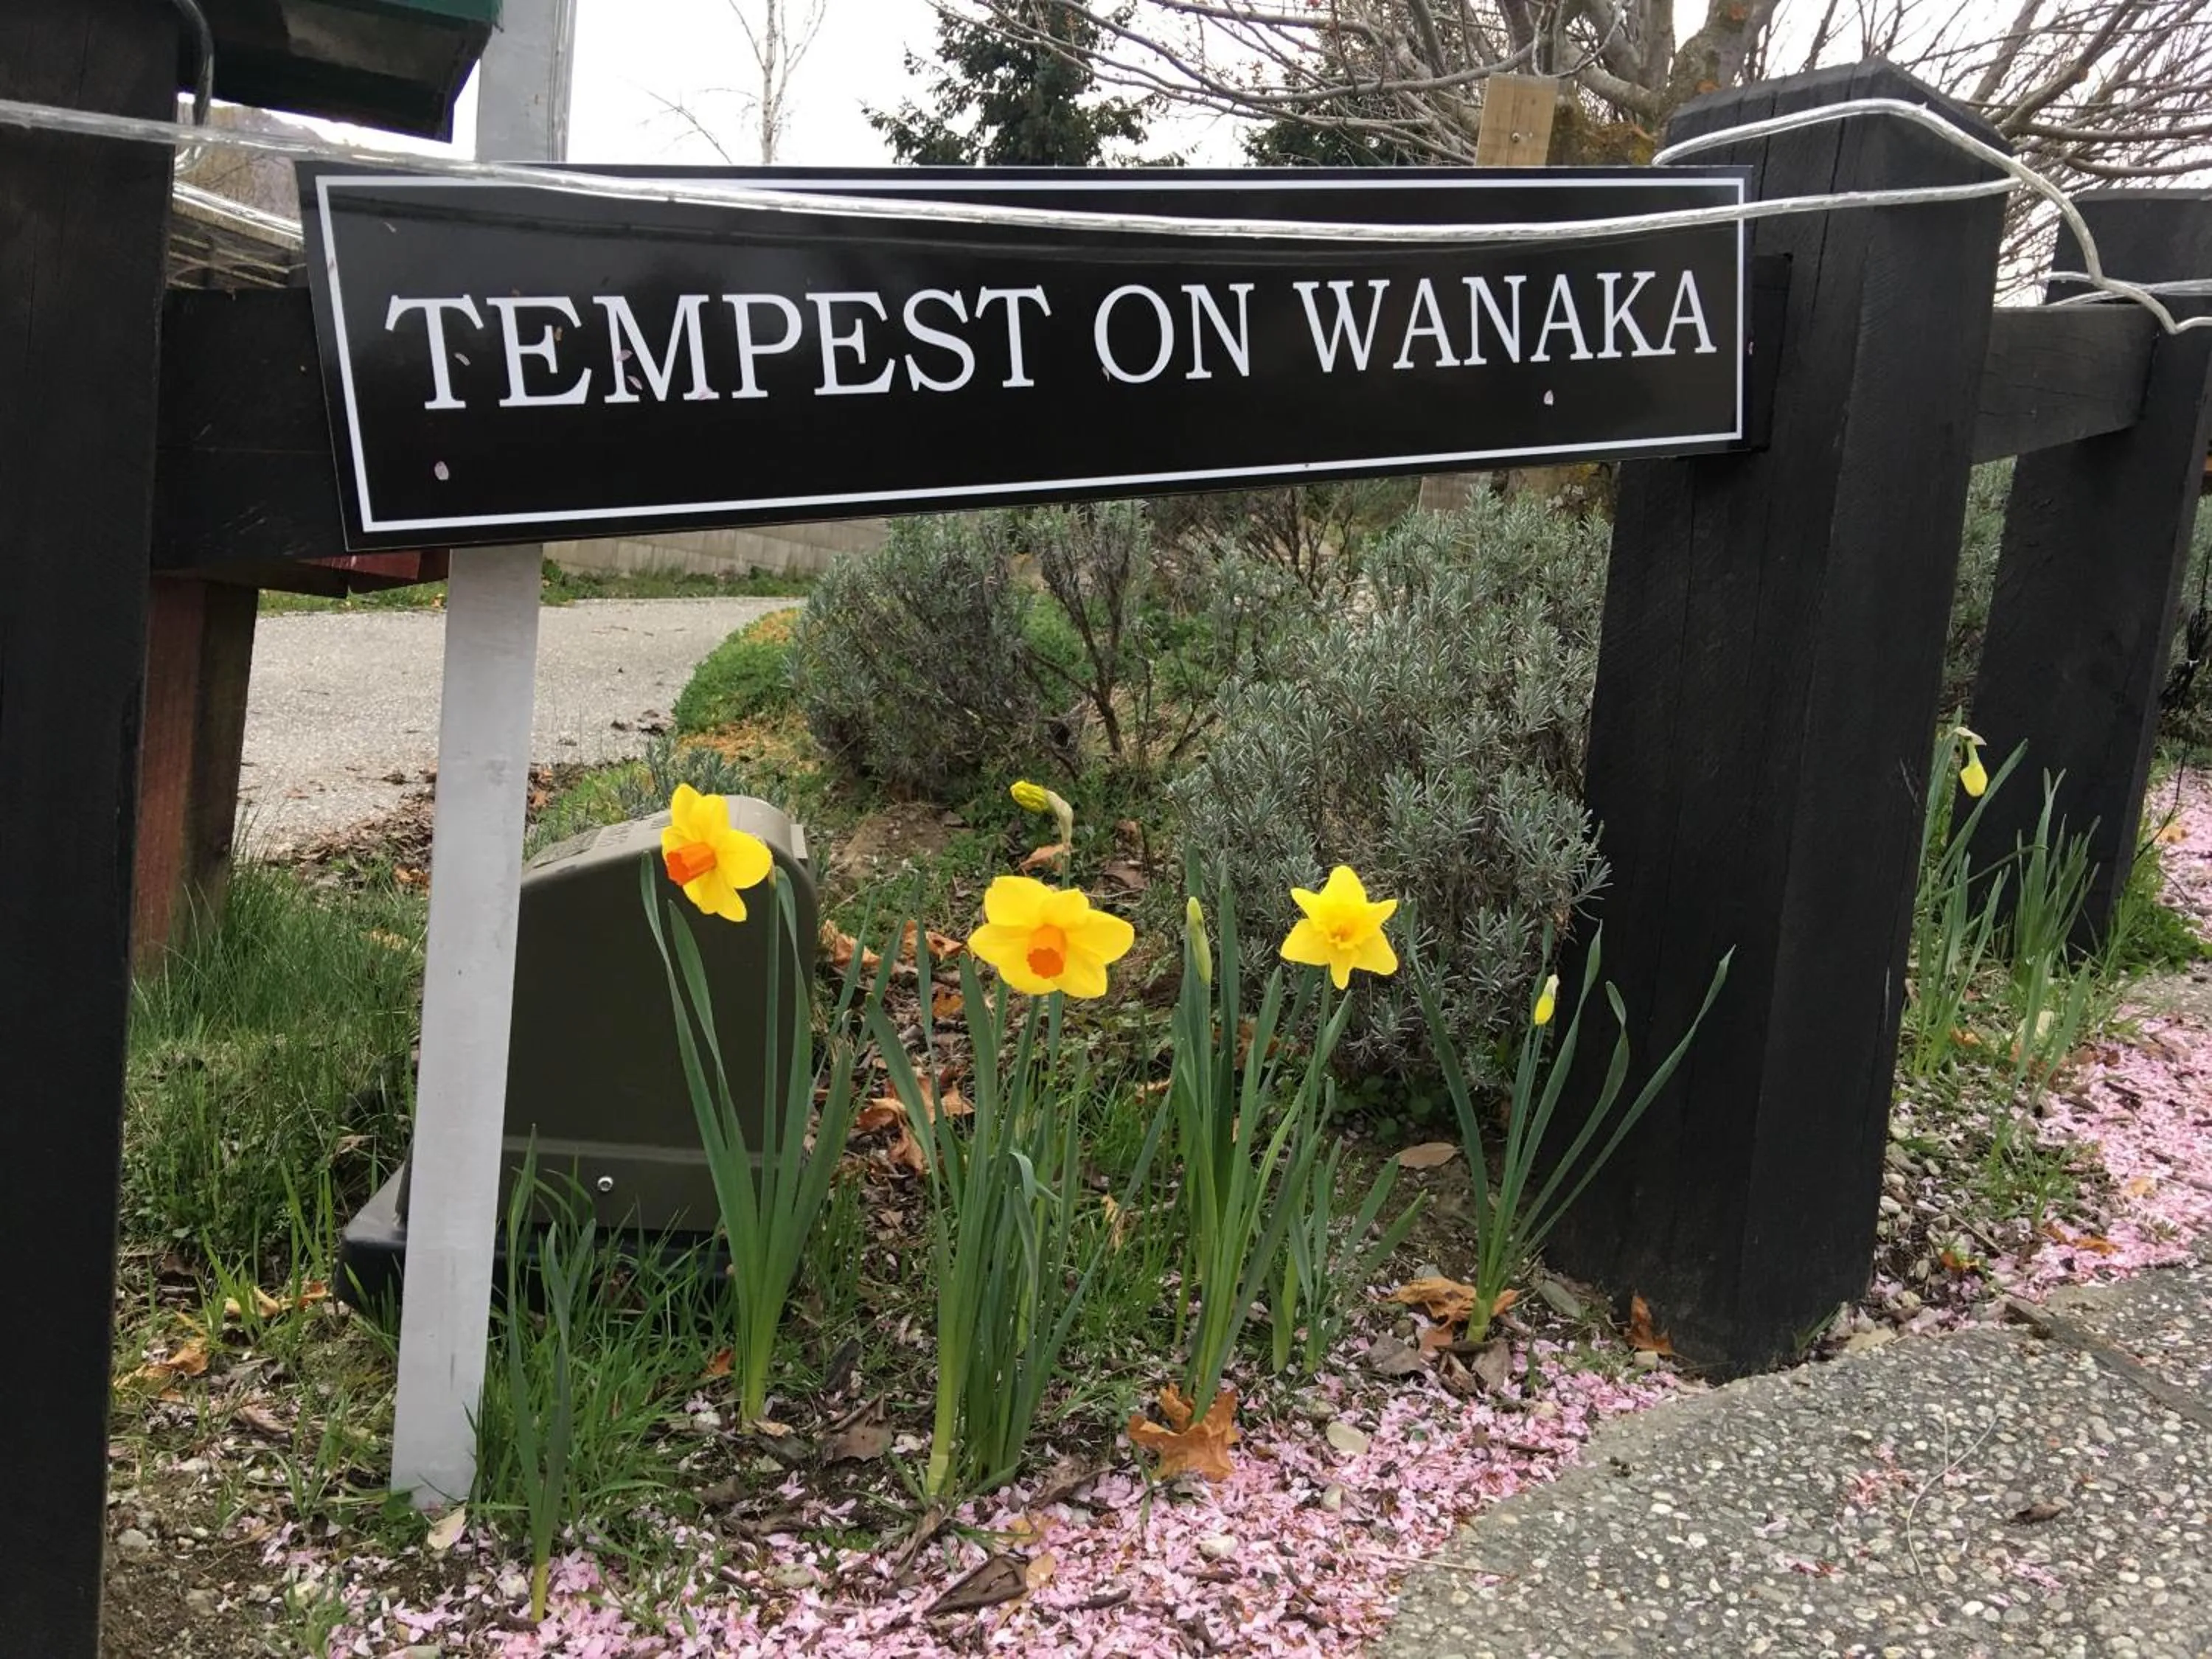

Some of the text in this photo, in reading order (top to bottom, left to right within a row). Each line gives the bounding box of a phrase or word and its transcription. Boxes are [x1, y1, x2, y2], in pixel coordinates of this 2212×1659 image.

[385, 269, 1717, 410] TEMPEST ON WANAKA
